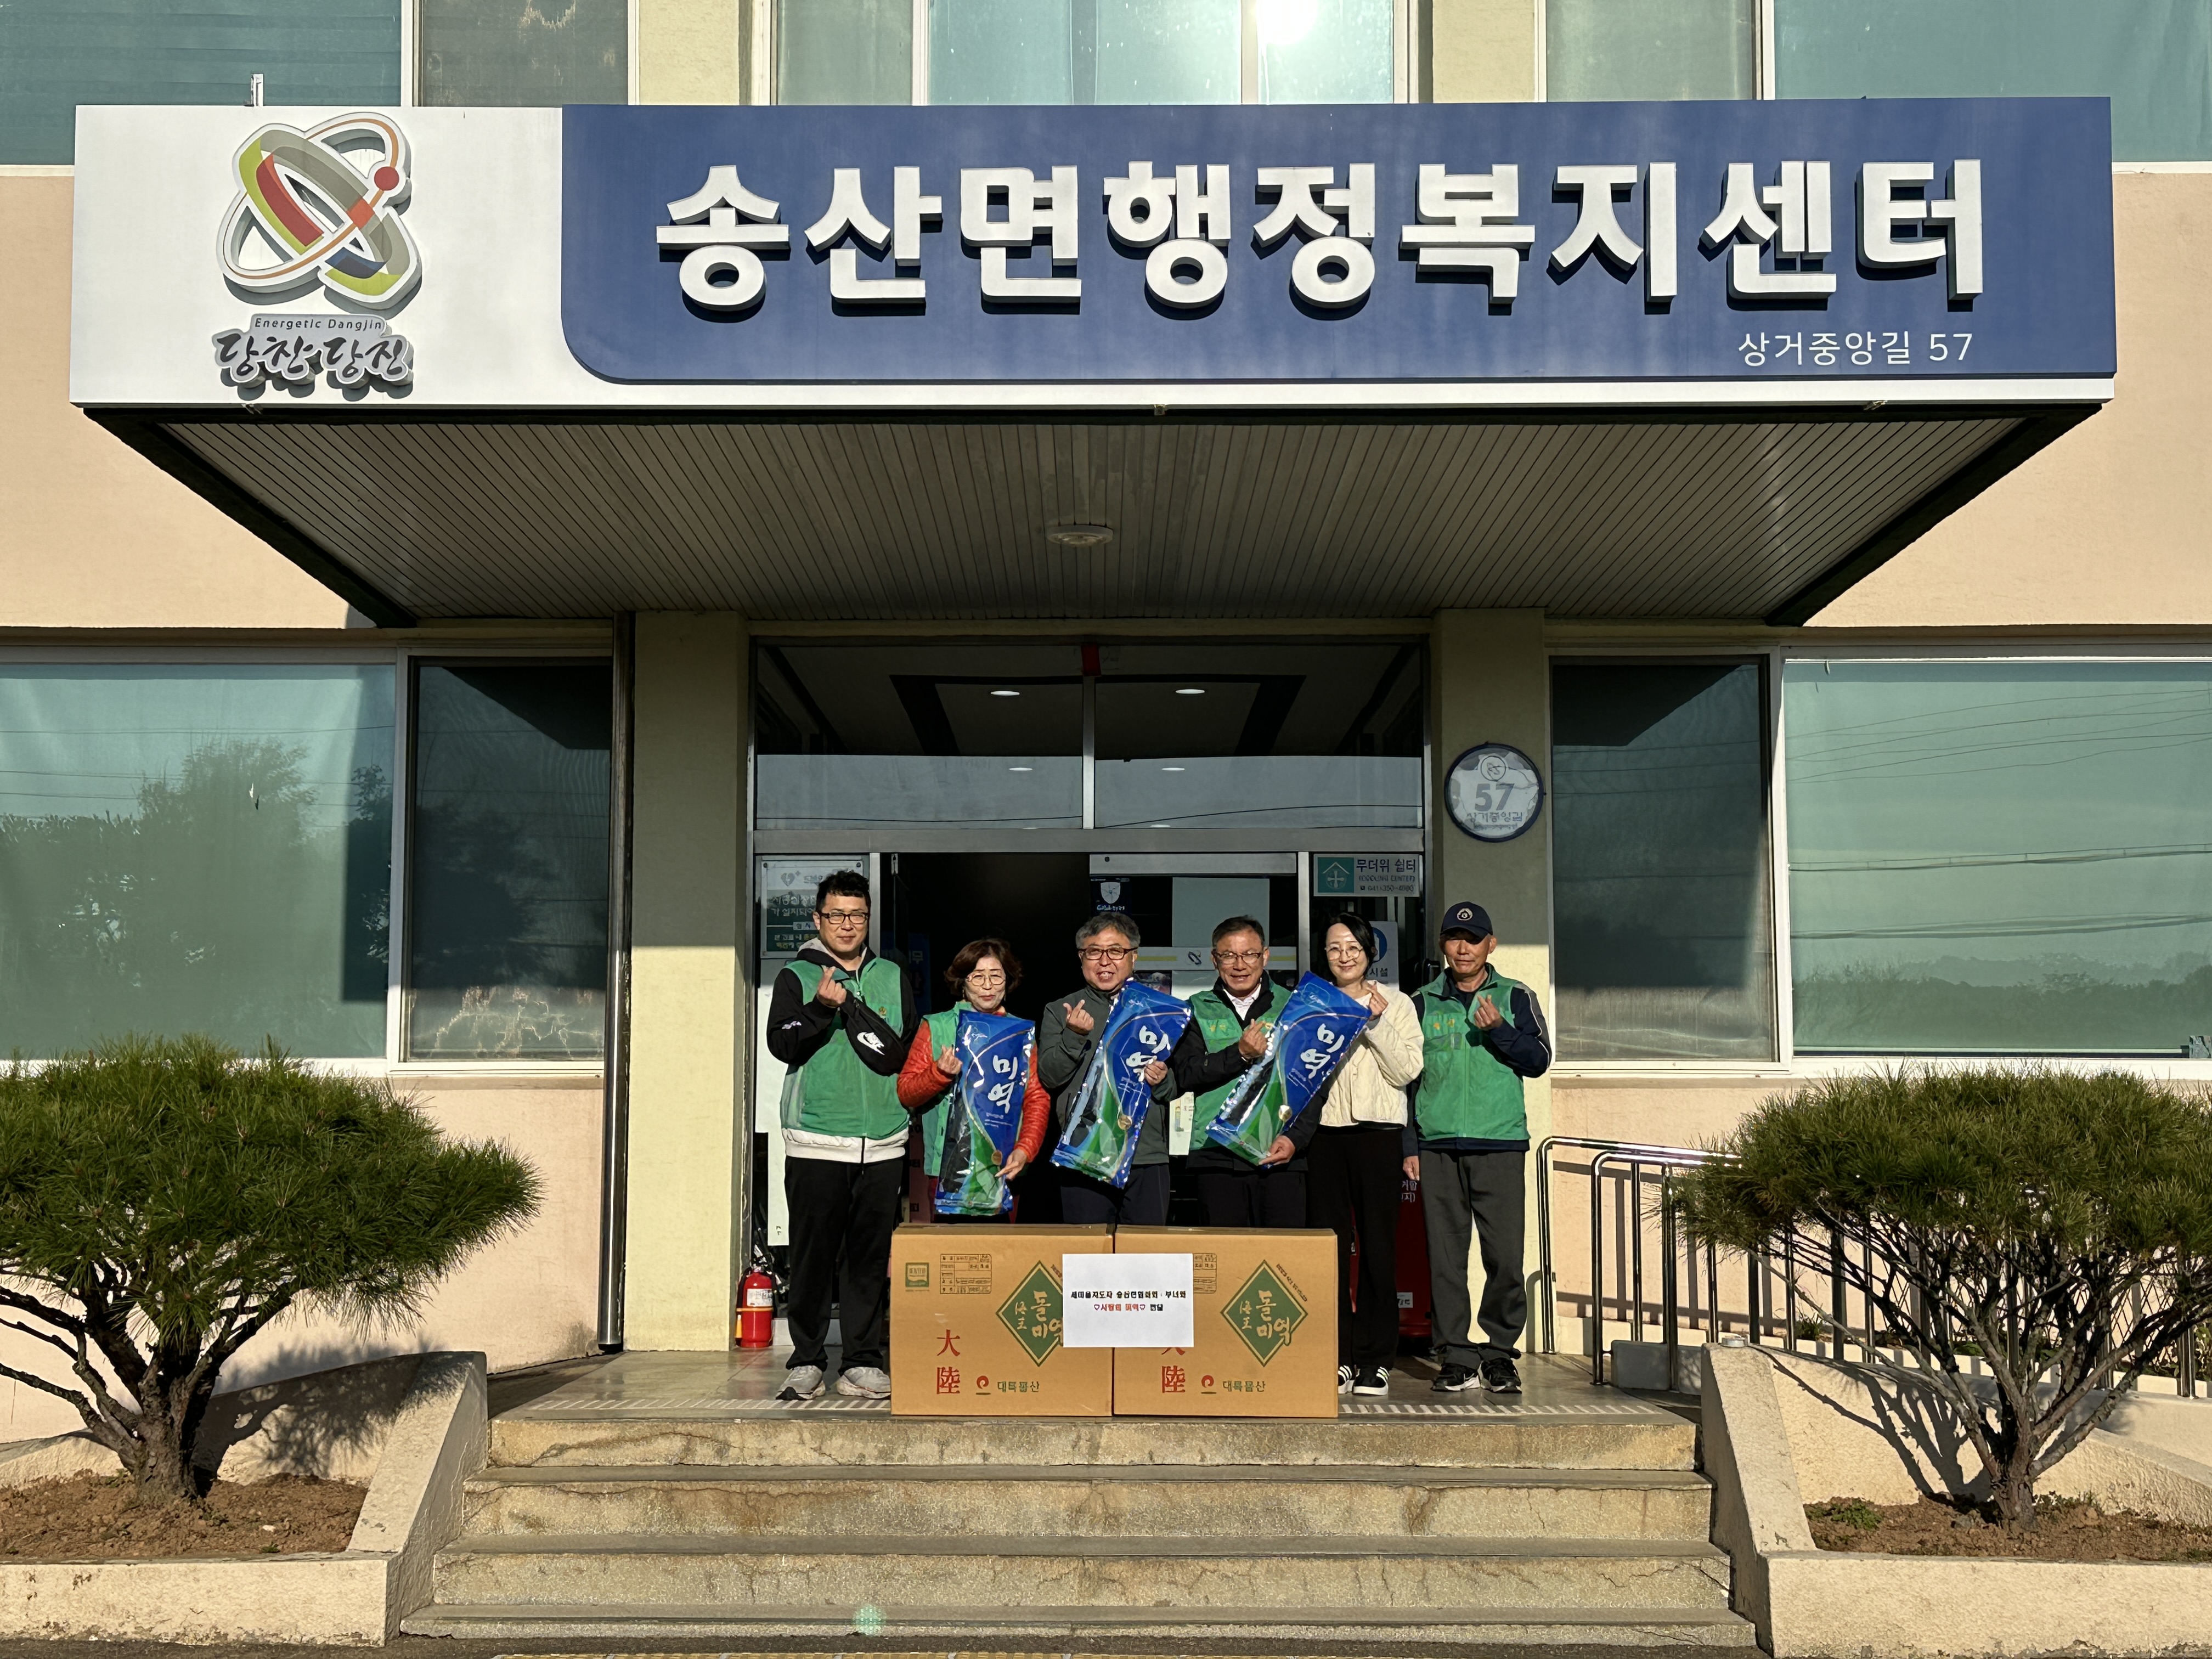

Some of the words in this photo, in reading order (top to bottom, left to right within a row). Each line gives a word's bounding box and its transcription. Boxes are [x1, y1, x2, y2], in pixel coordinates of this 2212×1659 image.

[656, 159, 1983, 311] 송산면행정복지센터
[255, 318, 321, 330] Energetic
[328, 319, 382, 331] Dangjin
[1738, 331, 1910, 367] 상거중앙길
[1929, 333, 1973, 361] 57
[1474, 783, 1515, 811] 57
[1356, 859, 1390, 873] 무더위
[1365, 967, 1388, 977] 시설
[936, 1329, 961, 1395] 大陸
